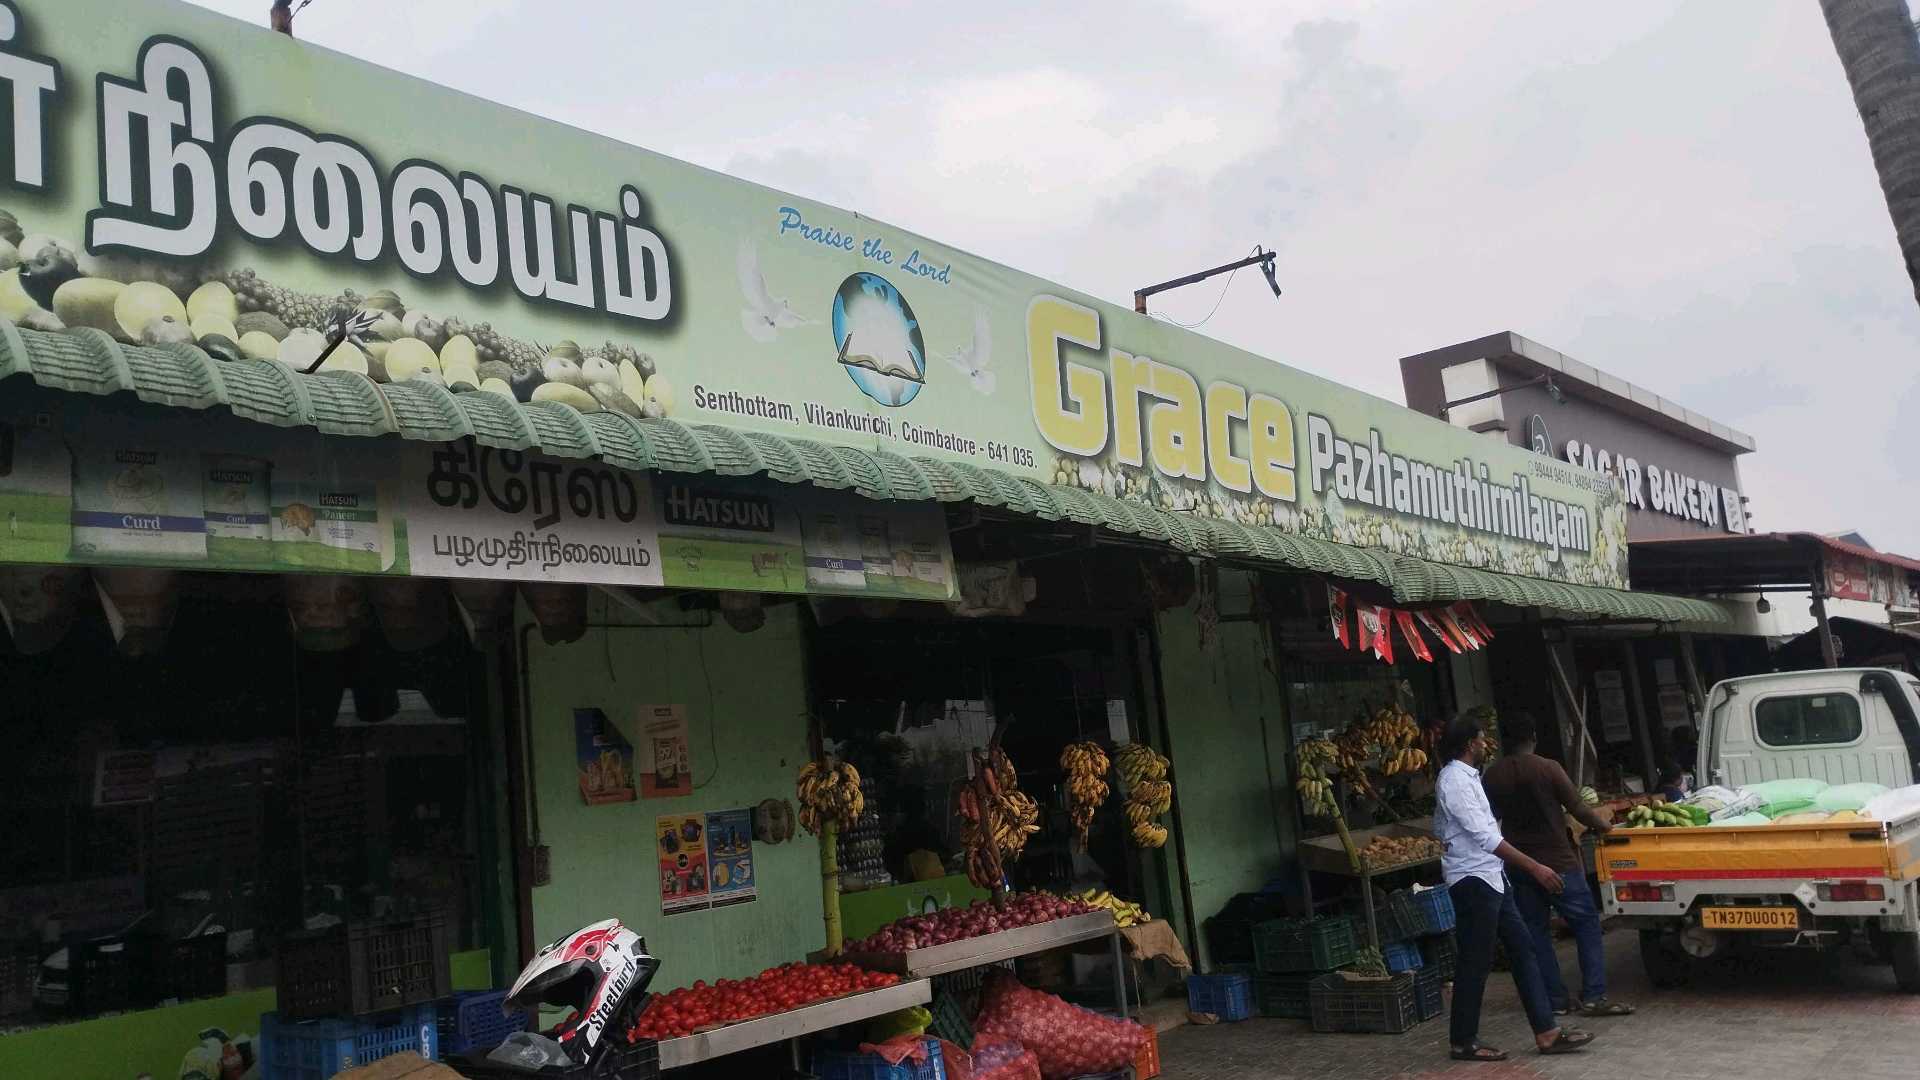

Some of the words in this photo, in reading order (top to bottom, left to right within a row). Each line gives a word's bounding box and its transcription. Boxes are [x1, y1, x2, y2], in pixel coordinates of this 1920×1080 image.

[90, 36, 673, 322] நிலையம்
[778, 206, 854, 251] Praise
[862, 237, 895, 265] the
[900, 250, 951, 285] Lord
[693, 384, 799, 424] Senthottam,
[902, 421, 976, 456] Coimbatore
[987, 440, 1010, 464] 641
[1025, 294, 1296, 502] Grace
[1308, 412, 1591, 563] Pazhamuthirnilayam
[122, 514, 161, 530] Curd
[667, 486, 769, 528] HATSUN
[1648, 464, 1719, 526] BAKERY
[432, 530, 650, 571] பழமுதிர்நிலையம்
[1711, 909, 1796, 926] TN37DU0012
